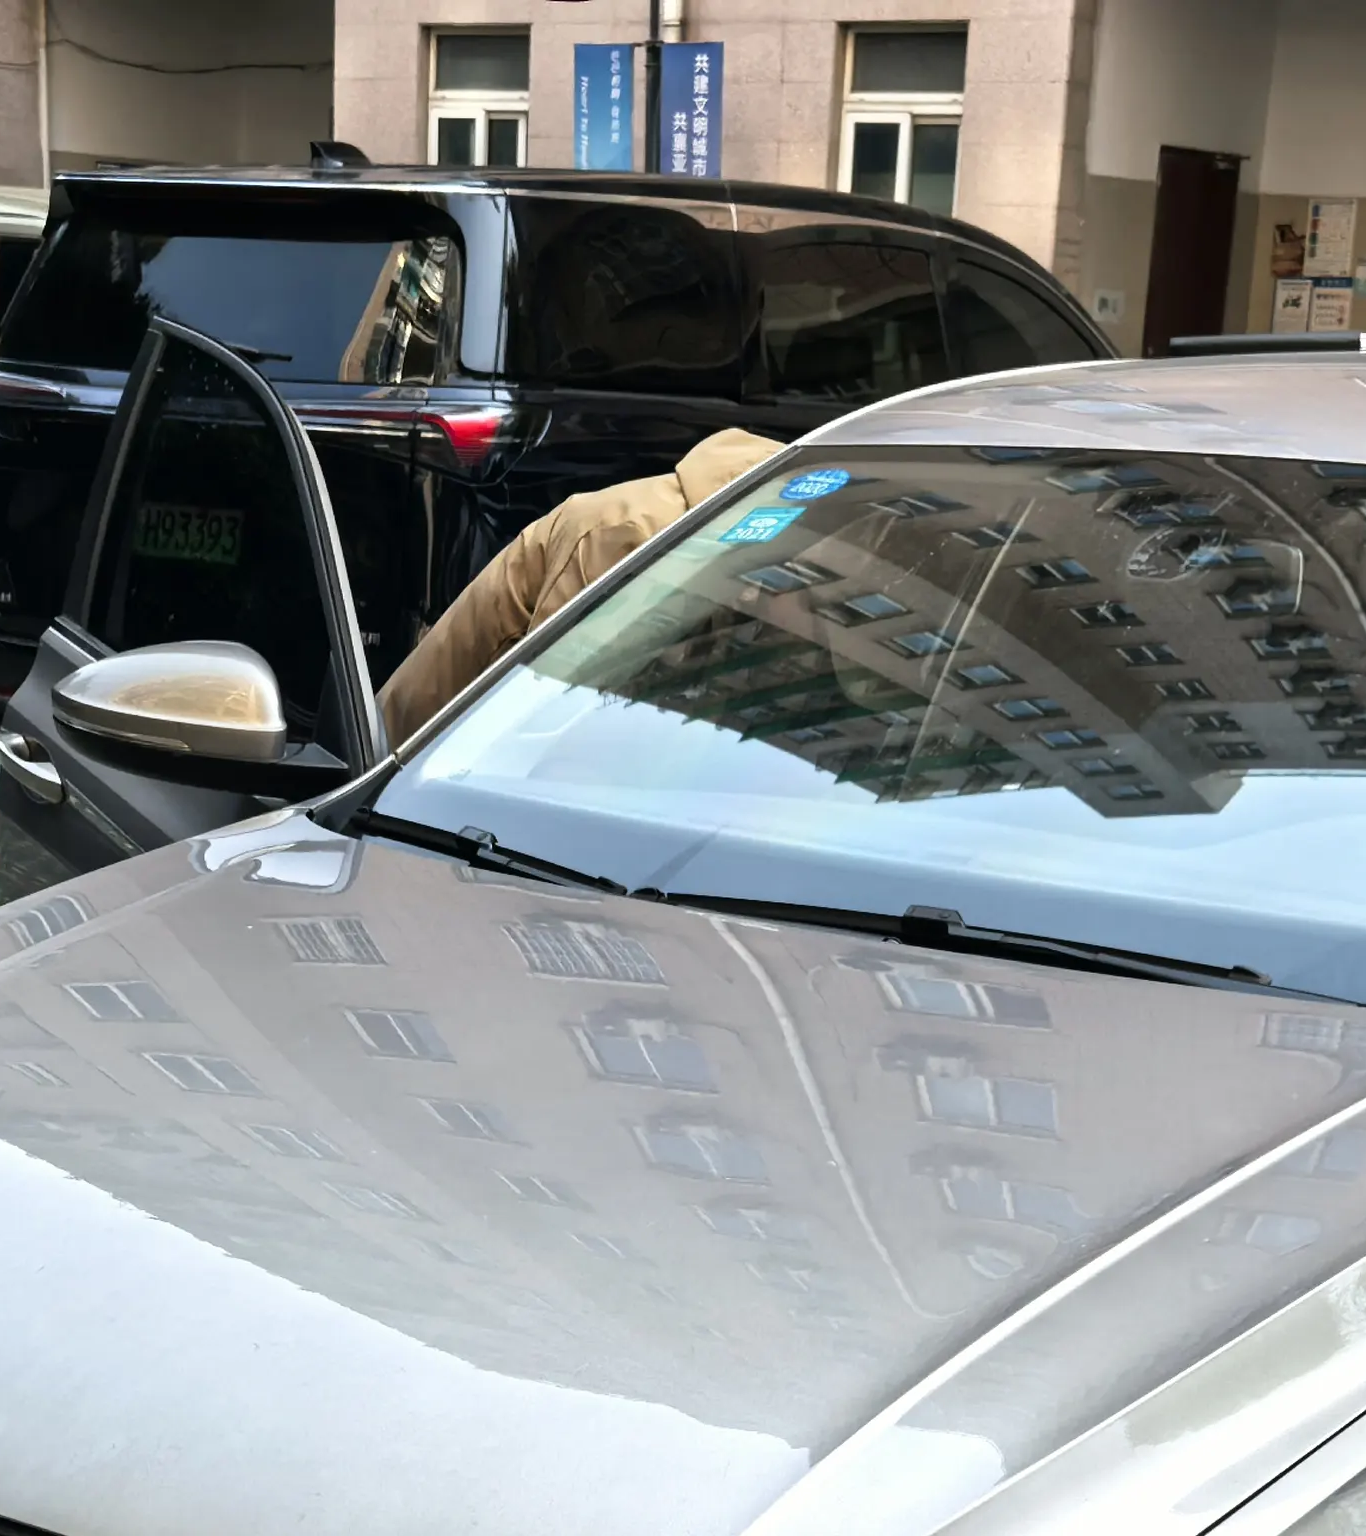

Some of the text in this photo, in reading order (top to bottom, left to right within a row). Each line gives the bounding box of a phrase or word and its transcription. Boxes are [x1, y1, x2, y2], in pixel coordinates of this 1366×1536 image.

[691, 53, 710, 178] 共建文明城市
